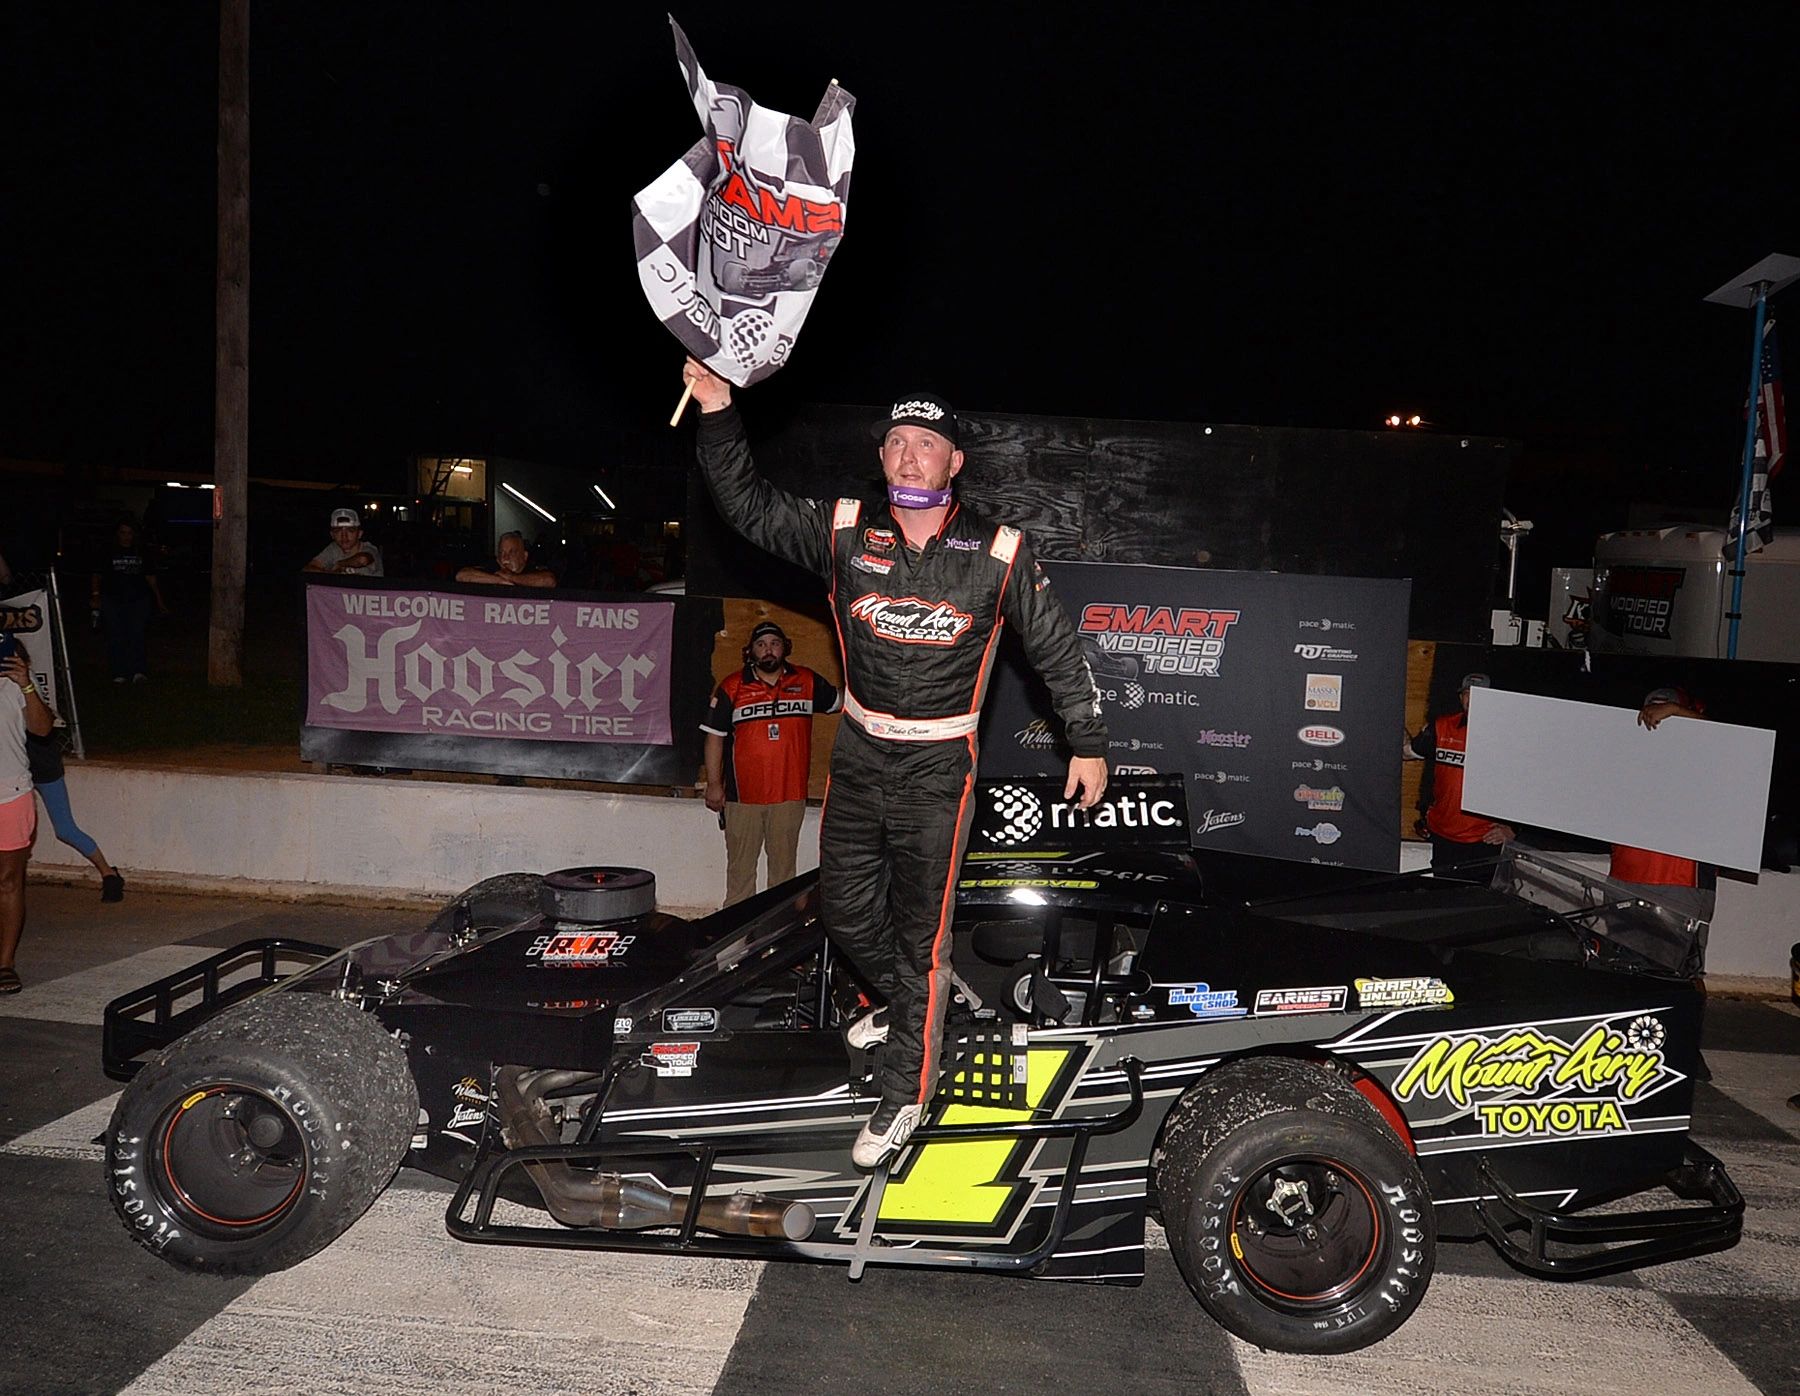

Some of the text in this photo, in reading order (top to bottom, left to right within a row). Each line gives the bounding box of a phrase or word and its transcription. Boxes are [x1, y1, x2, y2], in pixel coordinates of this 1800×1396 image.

[343, 594, 640, 630] WELCOME RACE FANS
[851, 596, 969, 636] Mount Airy
[877, 621, 951, 637] TOYOTA
[1081, 606, 1238, 638] SMART
[1299, 620, 1319, 628] pace
[1627, 614, 1666, 633] TOUR
[1099, 634, 1223, 657] MODIFIED
[320, 619, 656, 715] Hoosier
[1146, 655, 1218, 676] TOUR
[1148, 691, 1197, 706] matic
[741, 701, 807, 718] OFFCIAL
[422, 706, 634, 736] RACING TIRE
[1305, 729, 1339, 740] BELL
[1108, 739, 1128, 748] pace
[1292, 761, 1311, 769] pace
[1194, 772, 1214, 781] pace
[1051, 791, 1176, 828] matic
[1361, 978, 1430, 992] GRAFIX
[1170, 992, 1235, 1003] DRIVESHAFT
[1207, 1000, 1236, 1008] SHOP
[1260, 990, 1344, 1006] EARNEST
[1361, 989, 1447, 1002] UNLIMITED
[1397, 1028, 1658, 1104] Mount Airy
[1479, 1102, 1623, 1133] TOYOTA
[861, 1046, 1064, 1224] 1
